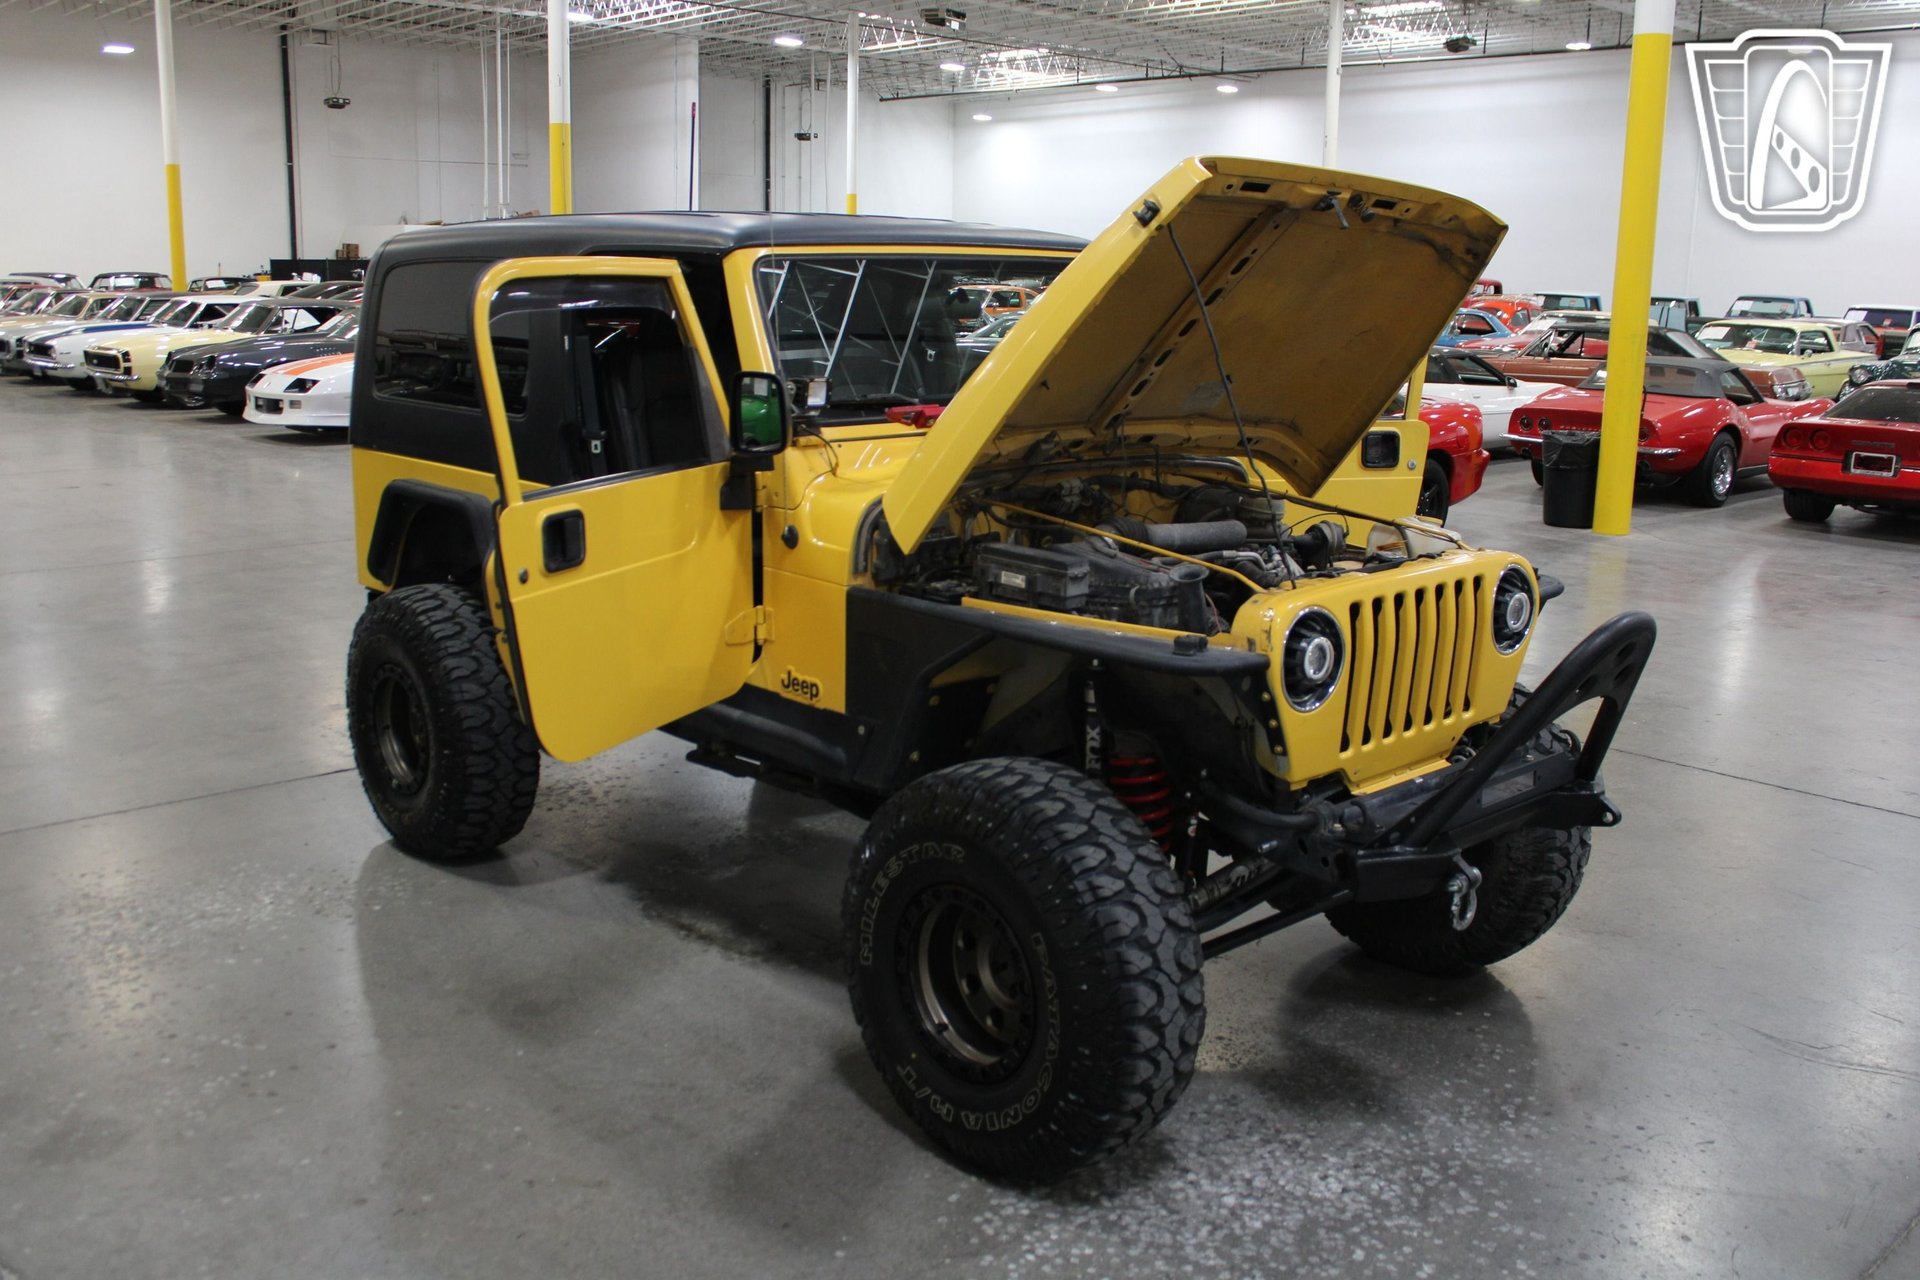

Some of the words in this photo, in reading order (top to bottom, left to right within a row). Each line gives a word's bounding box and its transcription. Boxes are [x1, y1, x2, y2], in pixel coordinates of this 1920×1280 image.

[780, 669, 820, 701] Jeep
[1085, 724, 1102, 770] FOX
[860, 841, 965, 967] MILESTAR
[960, 932, 1061, 1132] PATAGONIA
[896, 1063, 955, 1123] M/T
